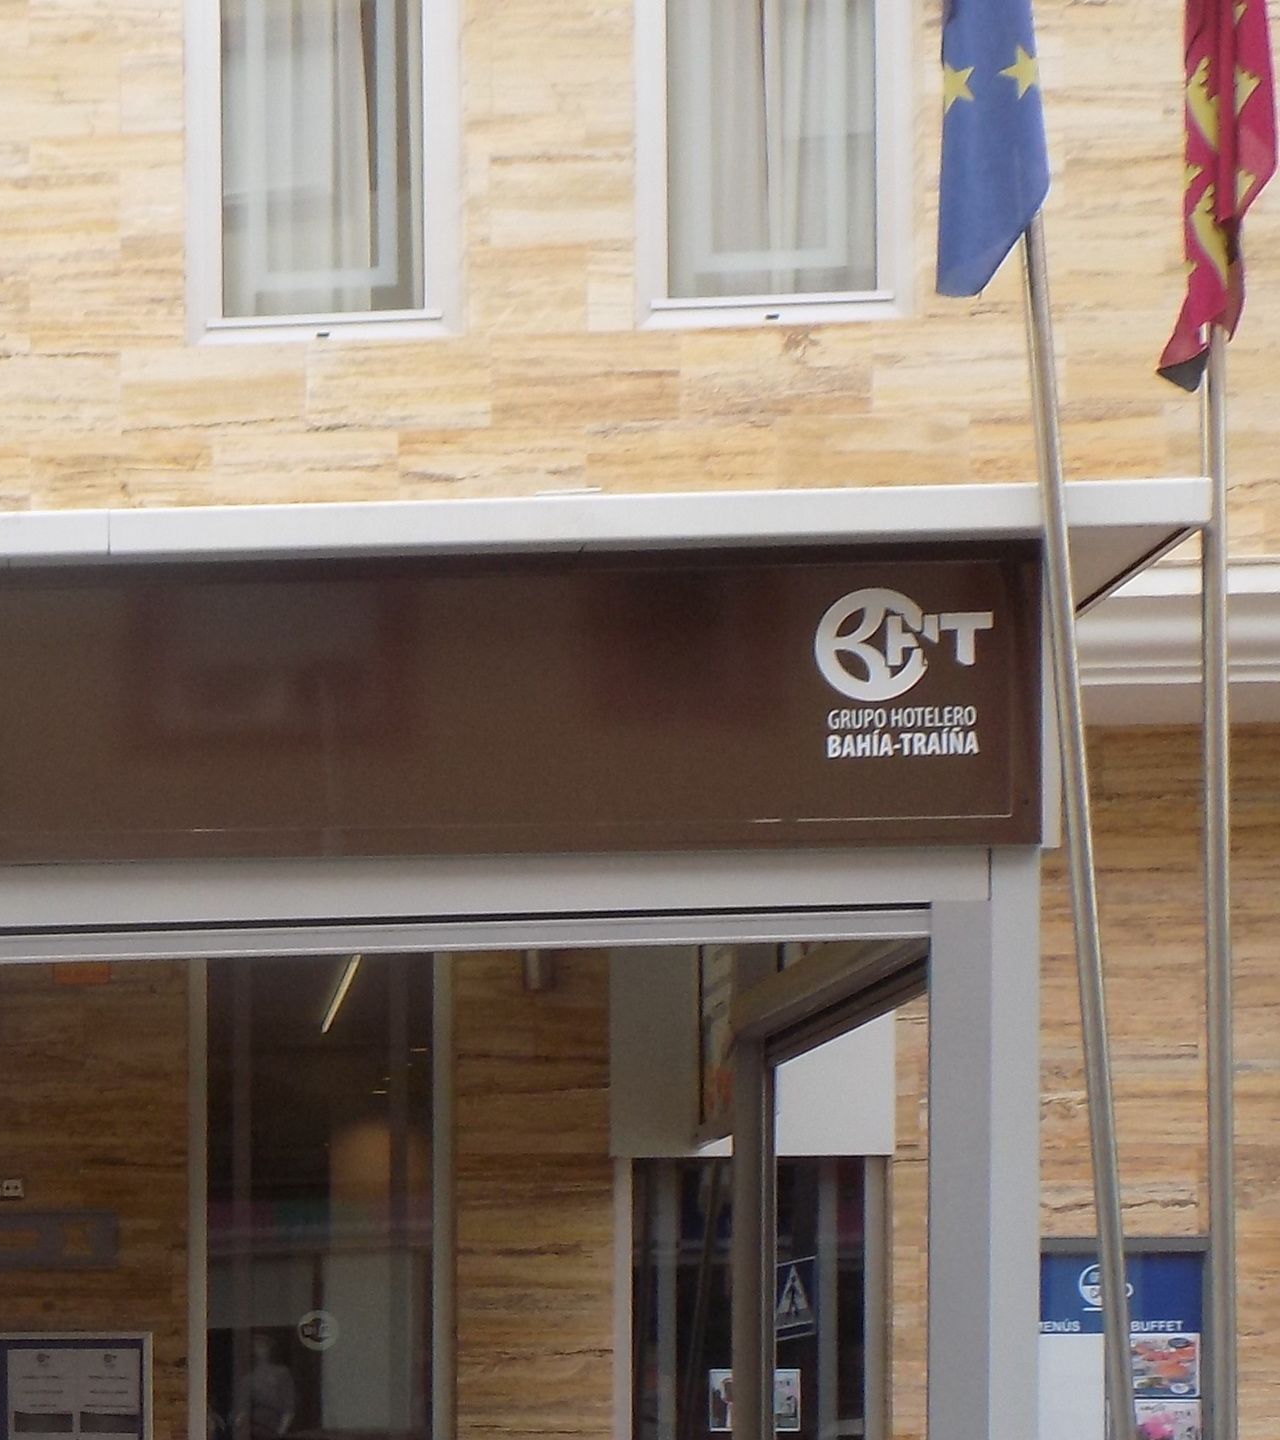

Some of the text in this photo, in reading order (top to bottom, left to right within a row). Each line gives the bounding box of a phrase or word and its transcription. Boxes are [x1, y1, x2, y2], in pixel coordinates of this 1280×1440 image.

[827, 705, 978, 730] GRUPO HOTELERO
[827, 727, 980, 758] BAHÍA-TRAÍÑA
[1130, 1320, 1184, 1332] BUFFET
